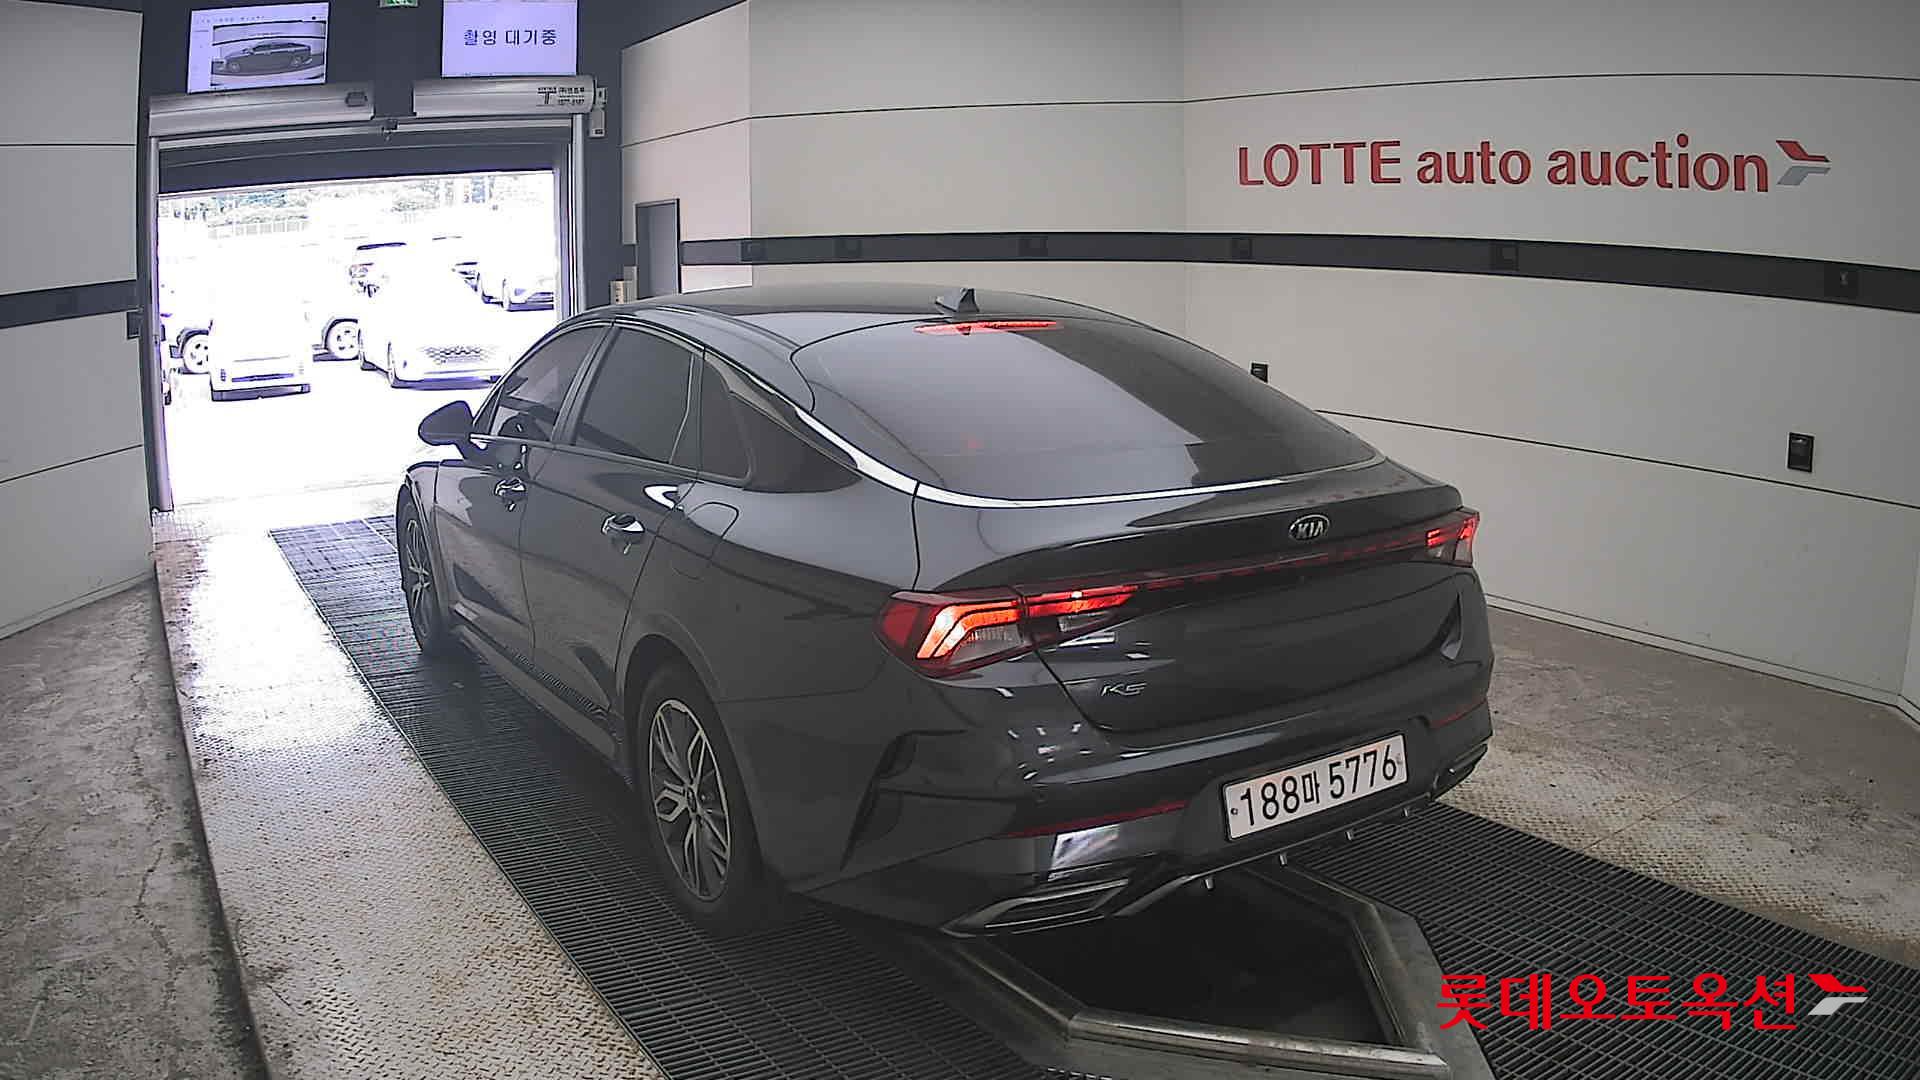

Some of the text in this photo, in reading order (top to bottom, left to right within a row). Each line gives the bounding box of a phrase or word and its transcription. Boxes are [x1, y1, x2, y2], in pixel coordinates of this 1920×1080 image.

[505, 29, 558, 46] 대기중
[1238, 133, 1770, 194] LOTTE auto auction
[1296, 520, 1328, 539] KIA
[1101, 683, 1147, 697] K5
[1240, 744, 1398, 827] 188마 5776
